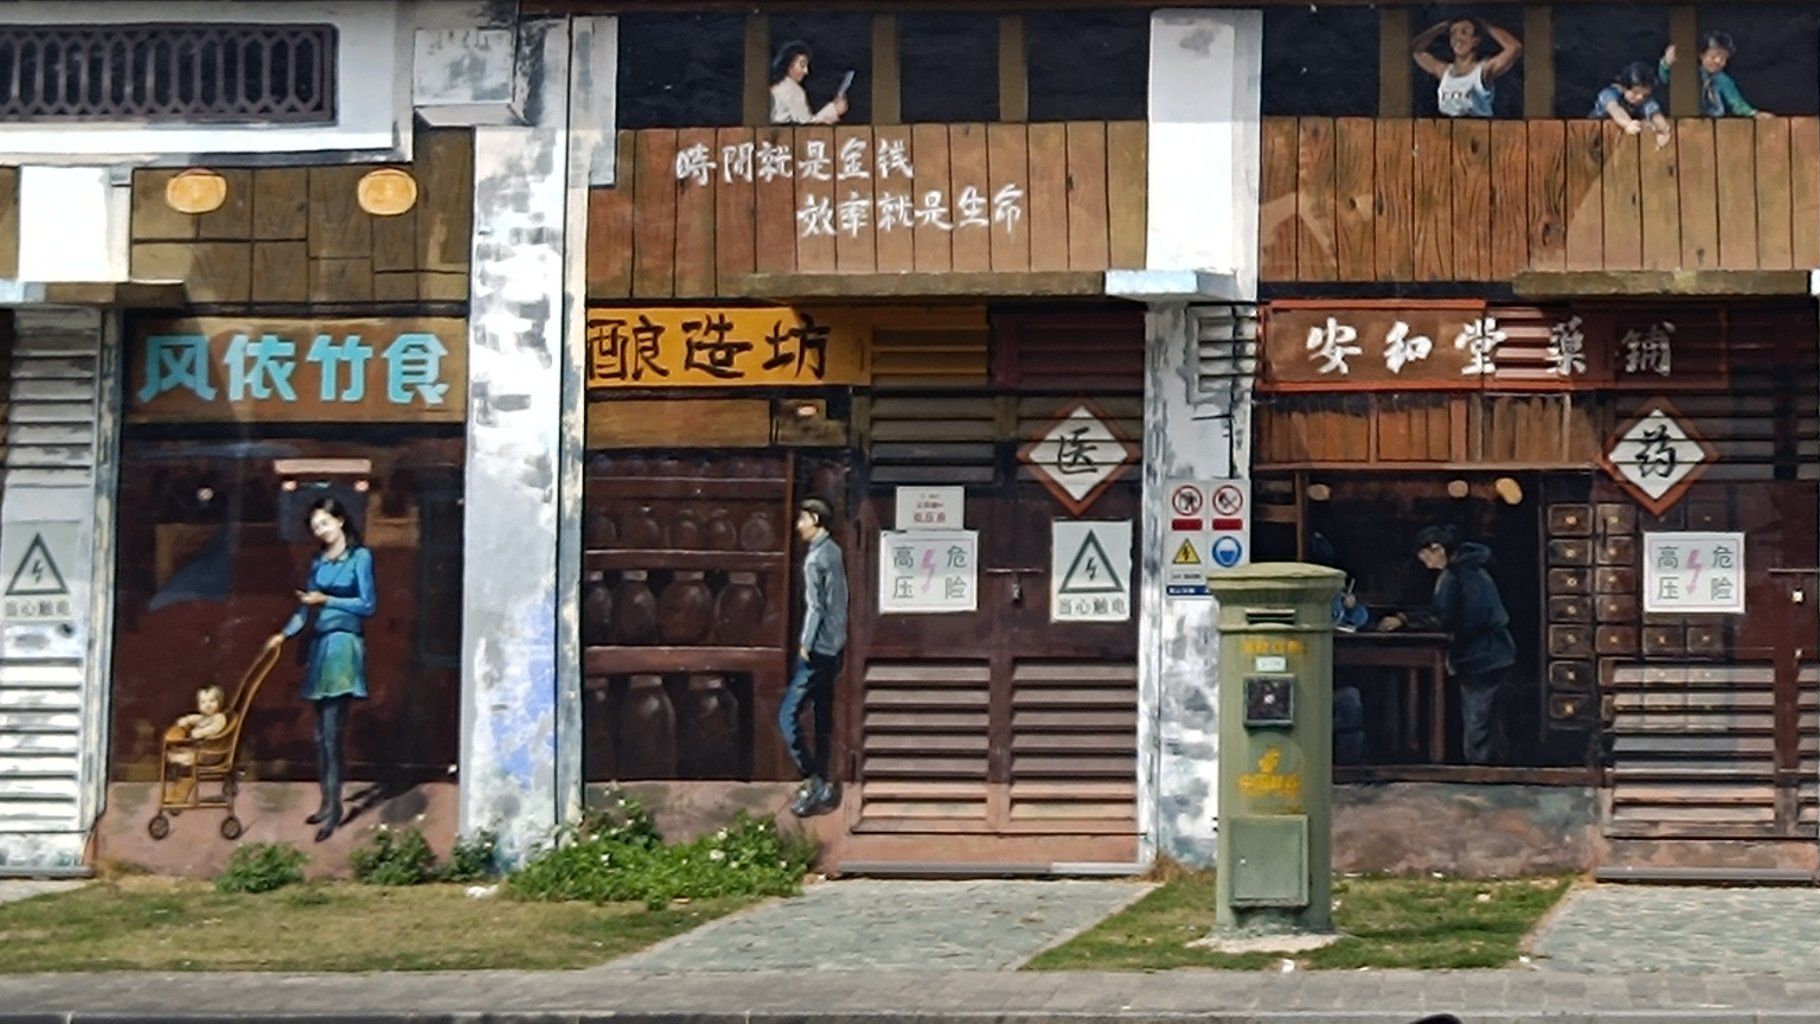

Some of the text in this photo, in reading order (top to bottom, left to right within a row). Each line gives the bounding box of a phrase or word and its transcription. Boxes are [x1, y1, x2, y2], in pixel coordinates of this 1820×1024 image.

[798, 184, 1024, 237] 效率就是生命
[587, 313, 830, 379] 酿造坊
[1057, 427, 1098, 474] 医
[1635, 424, 1676, 478] 药
